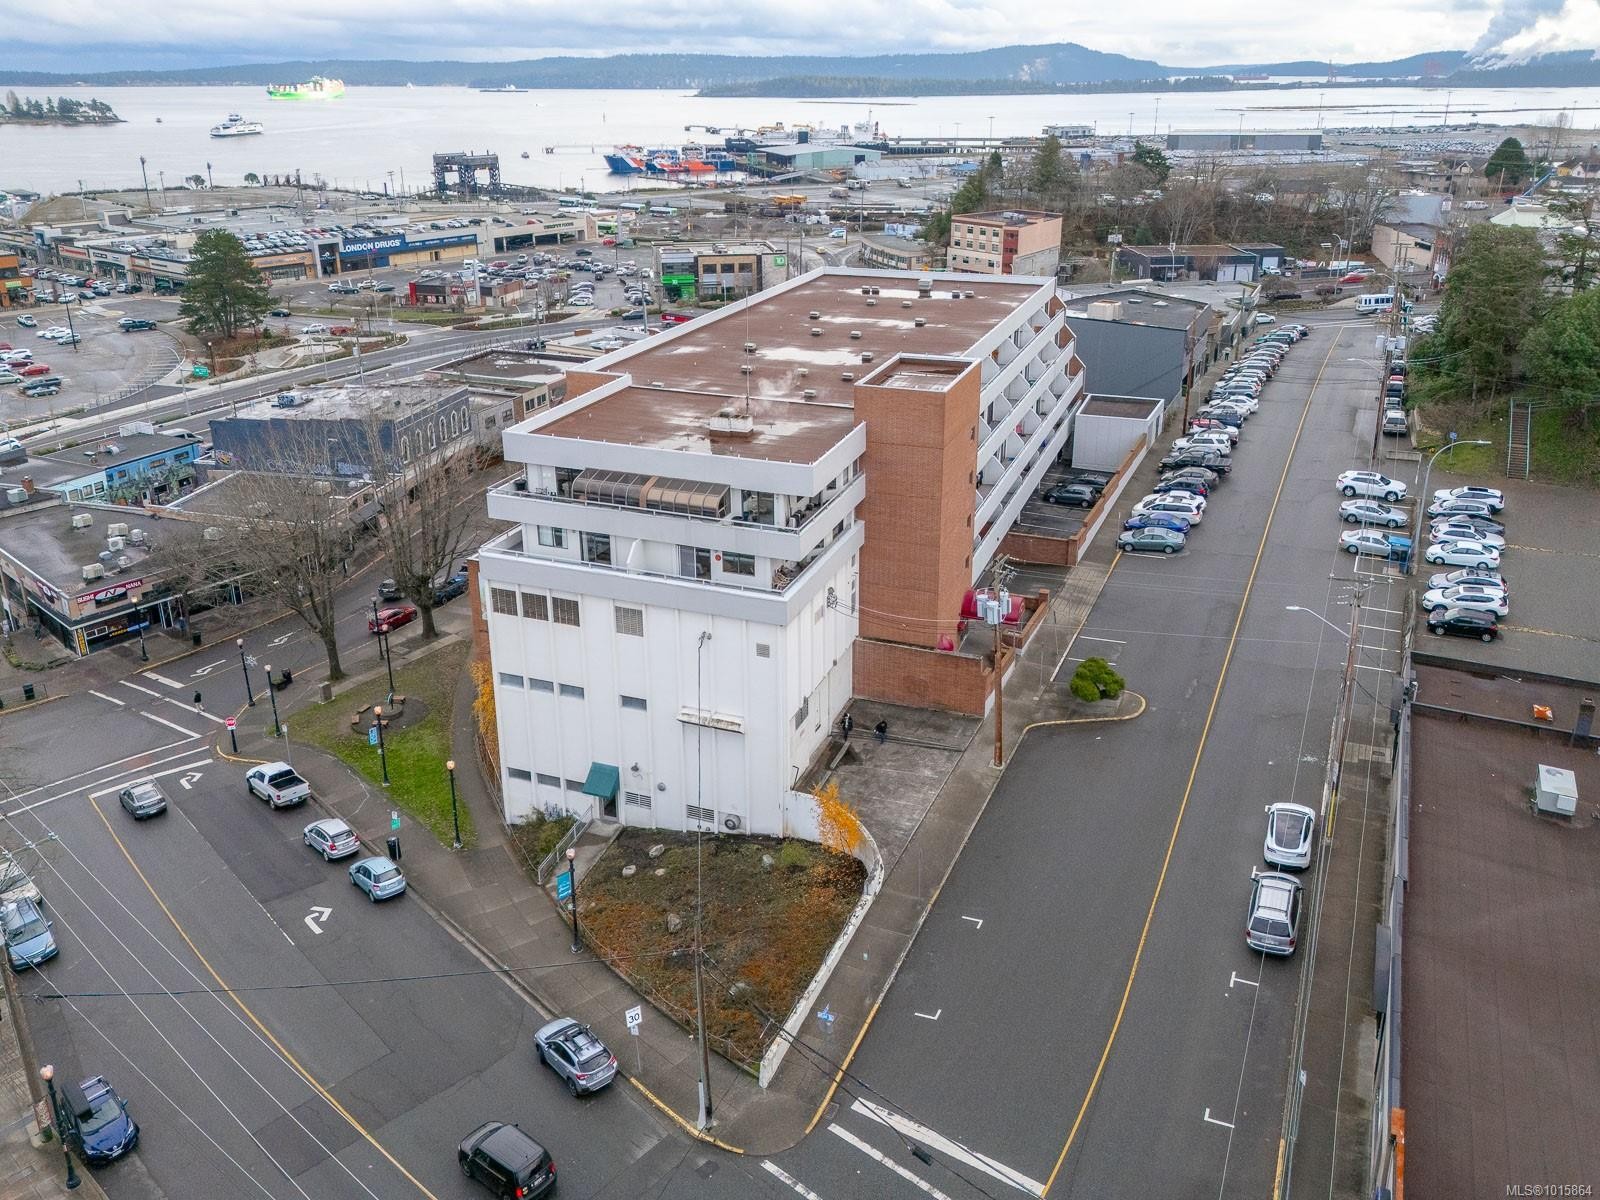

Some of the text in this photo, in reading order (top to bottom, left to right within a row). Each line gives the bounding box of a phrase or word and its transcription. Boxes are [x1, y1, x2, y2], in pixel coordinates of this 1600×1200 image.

[340, 242, 374, 253] LONDON
[375, 239, 400, 249] DRUGS
[77, 594, 94, 603] SUSHI
[125, 581, 142, 589] NANA
[628, 1013, 640, 1024] 30
